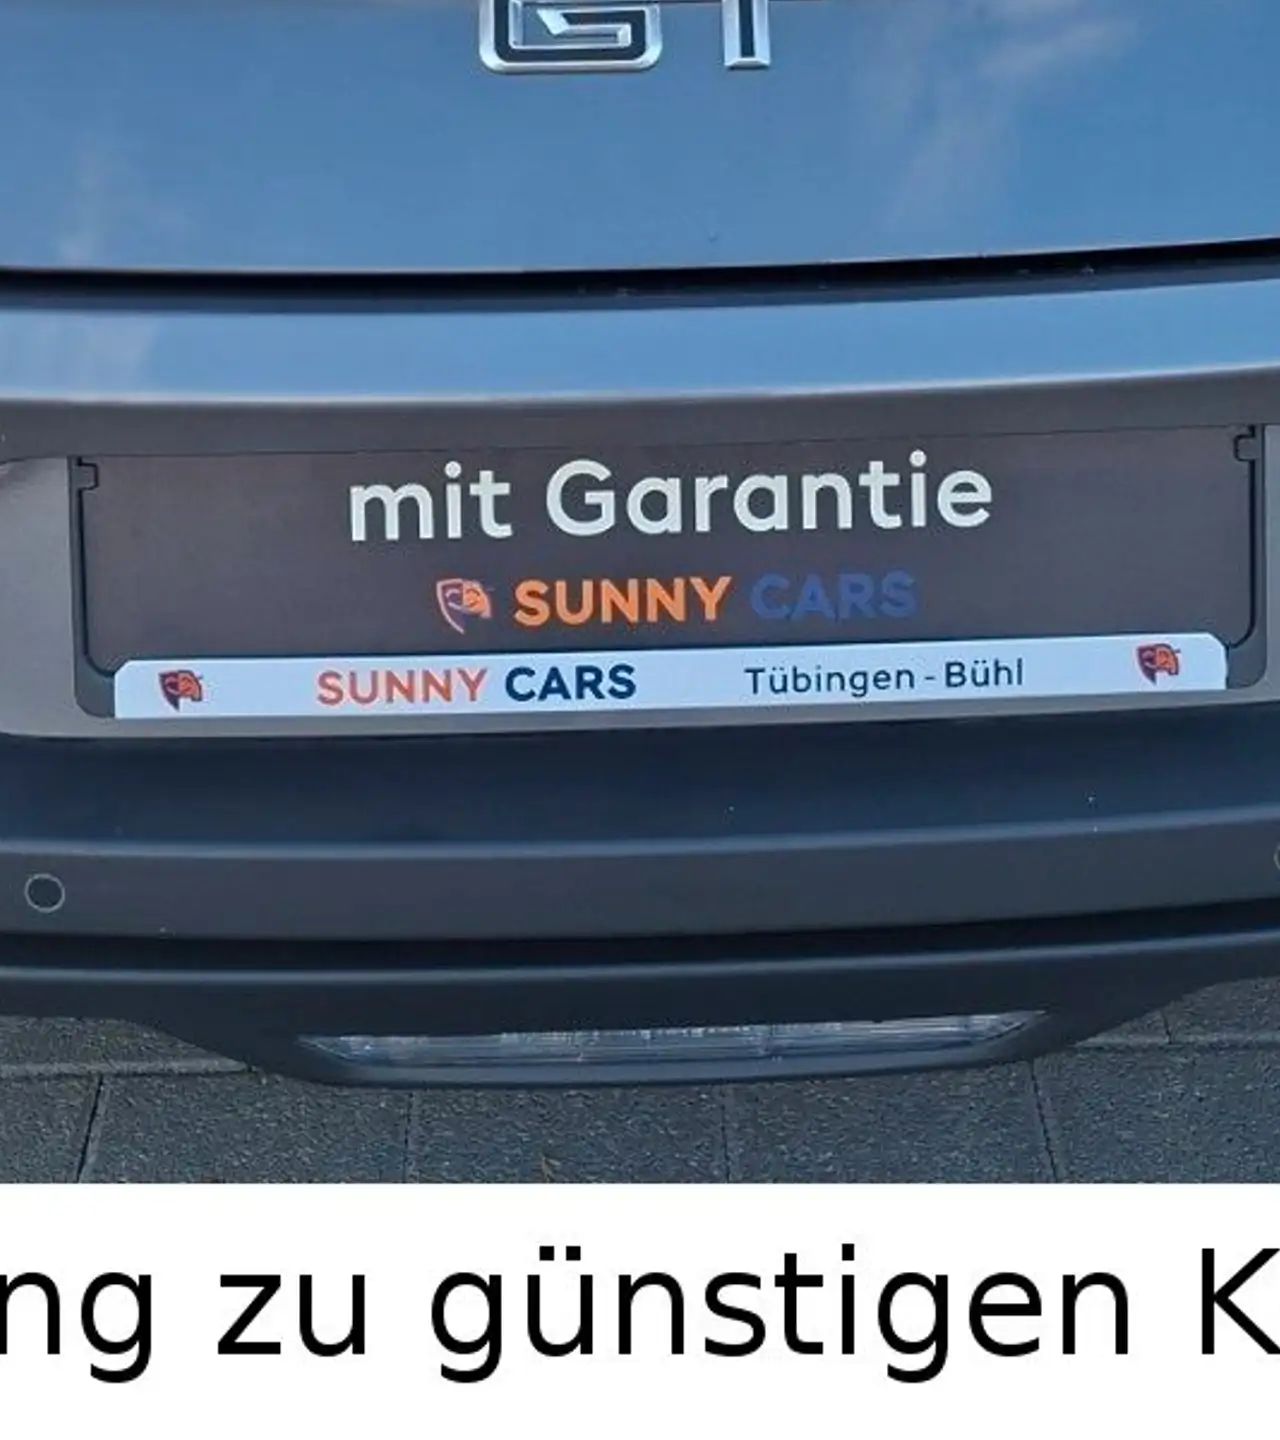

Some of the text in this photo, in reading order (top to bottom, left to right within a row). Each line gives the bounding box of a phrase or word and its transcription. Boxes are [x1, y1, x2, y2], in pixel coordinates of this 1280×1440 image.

[348, 449, 993, 543] mit Garantie
[513, 570, 917, 627] SUNNY CARS
[316, 663, 637, 706] SUNNY CARS
